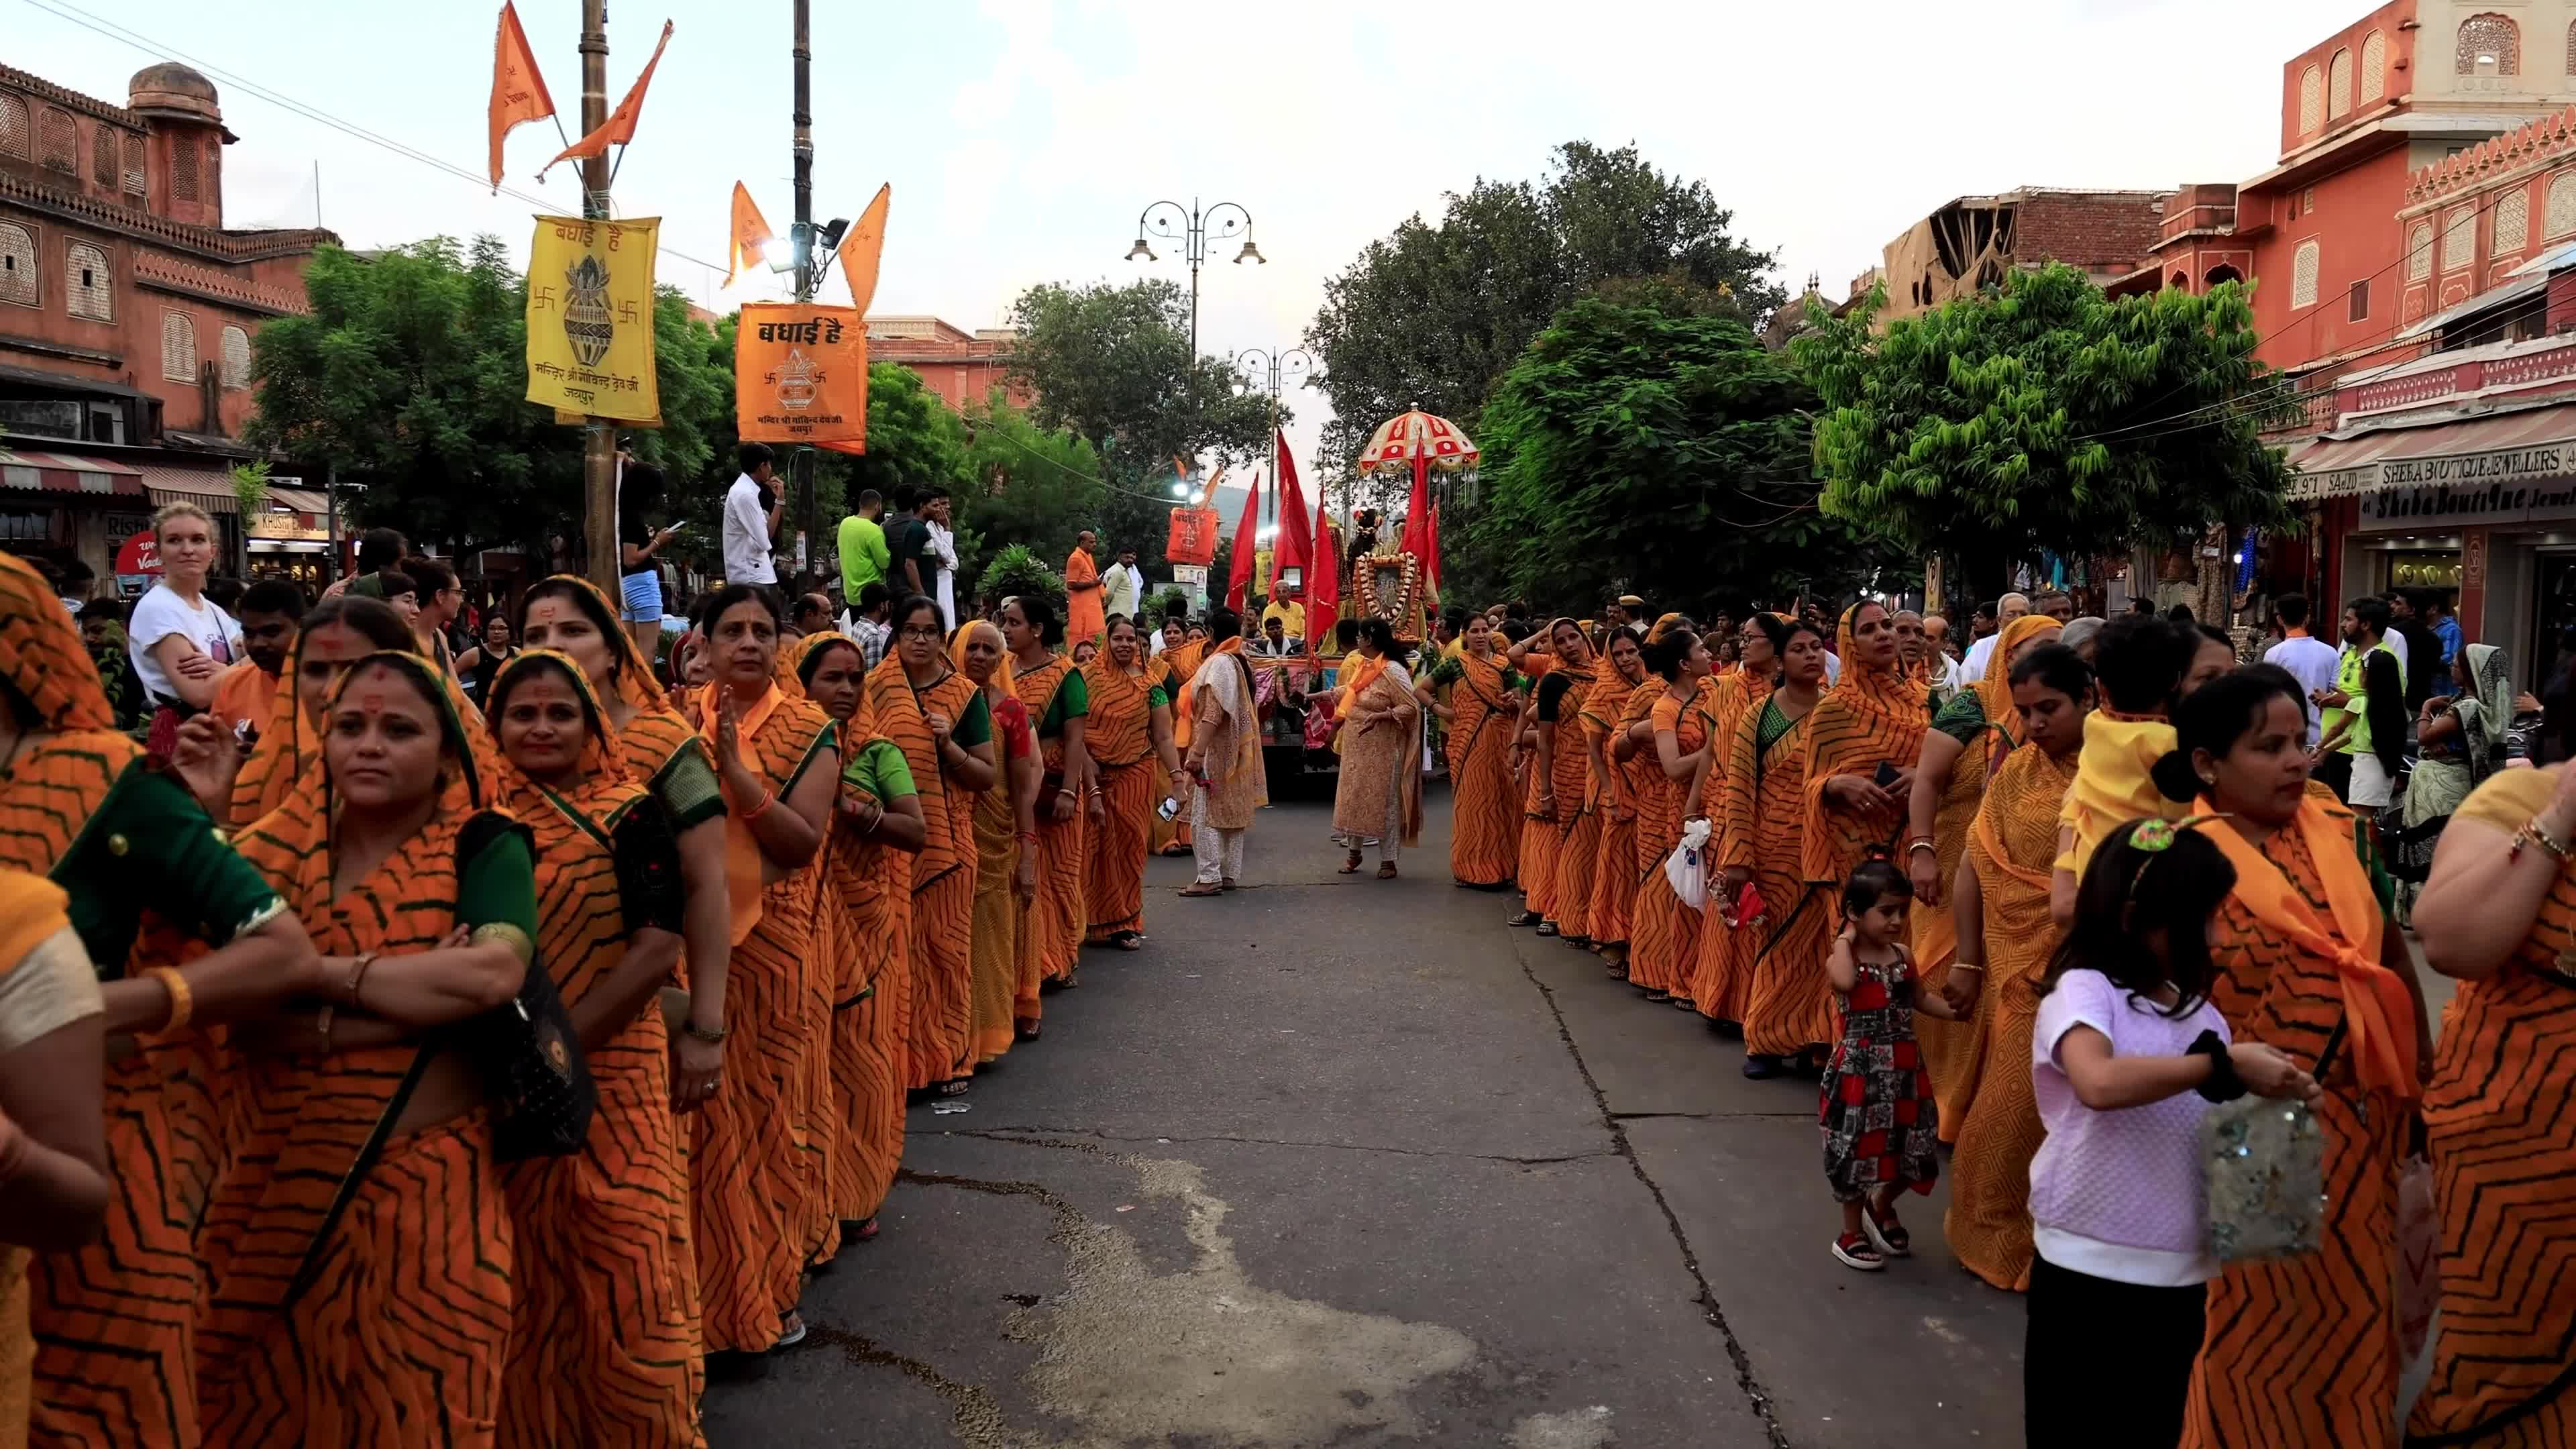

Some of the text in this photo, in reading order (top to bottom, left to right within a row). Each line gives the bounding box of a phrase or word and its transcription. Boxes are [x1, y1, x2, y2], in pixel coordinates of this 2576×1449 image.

[759, 317, 845, 345] बधाई है
[564, 386, 595, 407] जयपुर
[2383, 463, 2424, 484] SHEBA
[2424, 456, 2486, 481] BOUTIQUE
[2486, 447, 2561, 476] JEWELLERS
